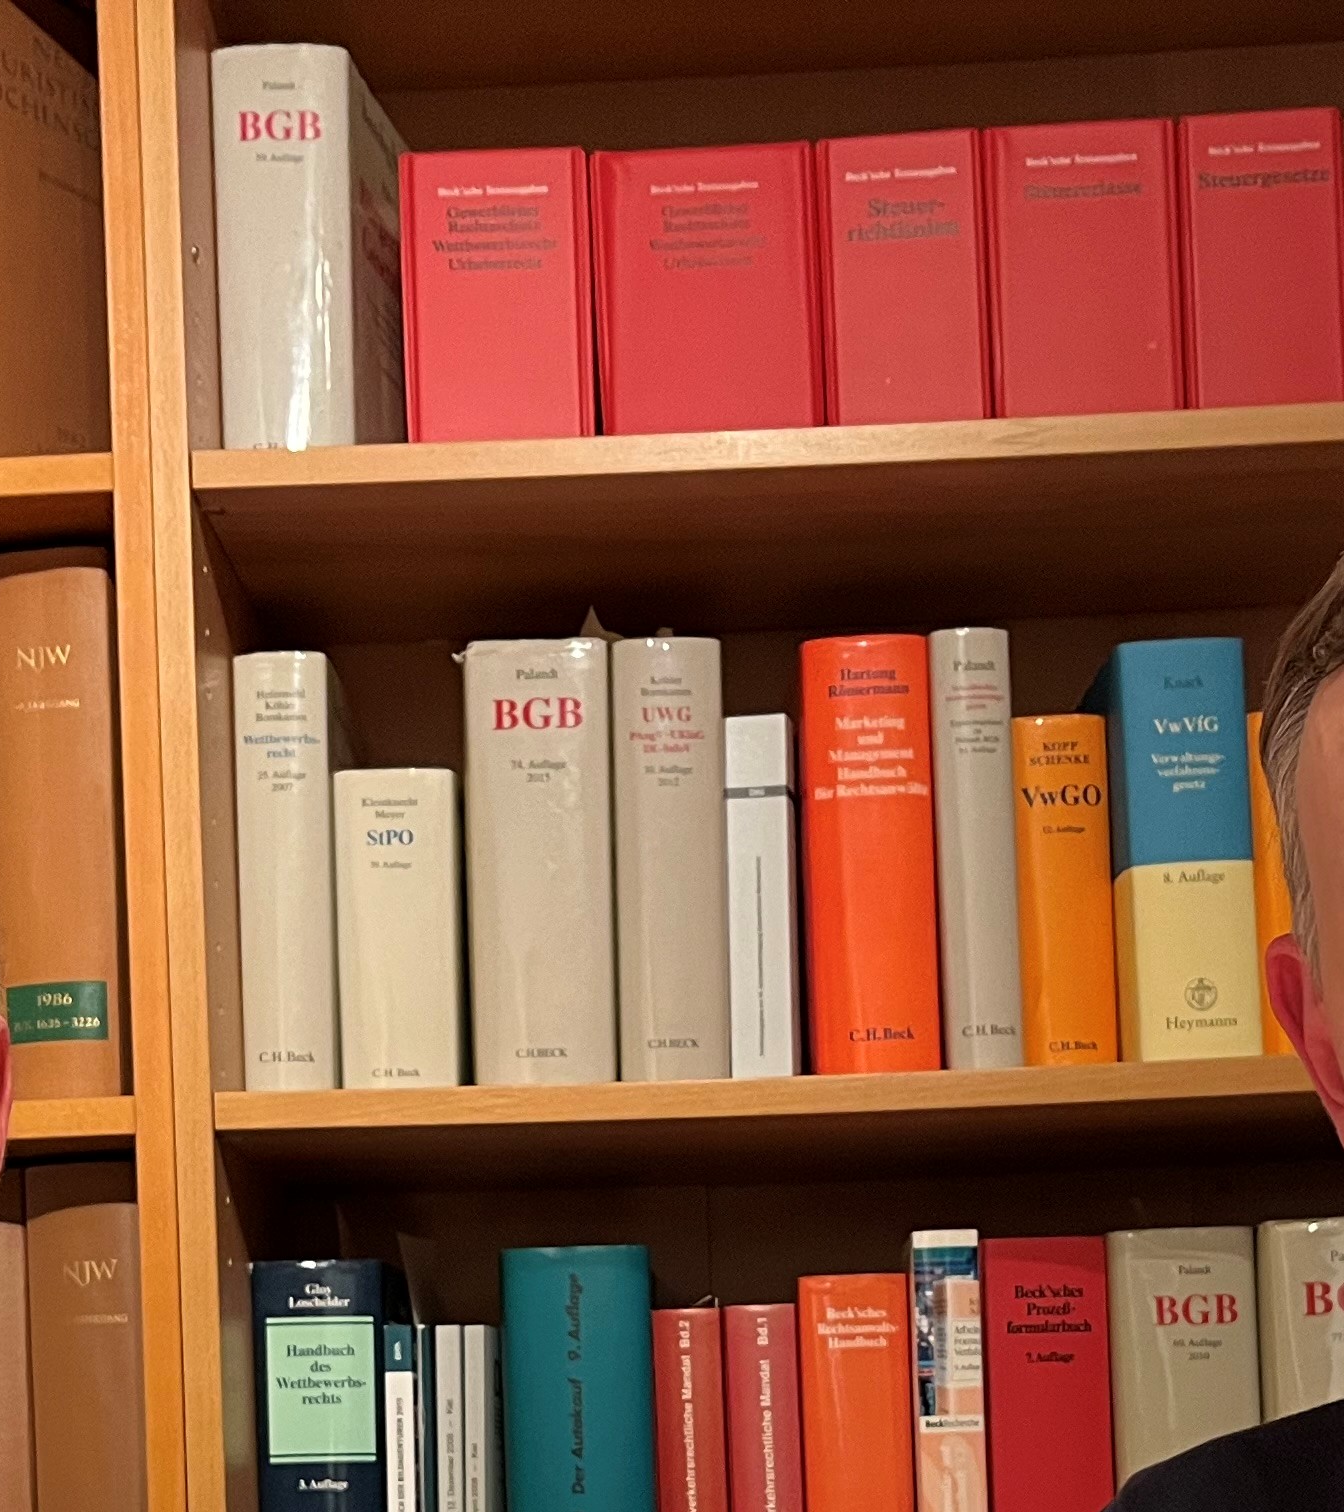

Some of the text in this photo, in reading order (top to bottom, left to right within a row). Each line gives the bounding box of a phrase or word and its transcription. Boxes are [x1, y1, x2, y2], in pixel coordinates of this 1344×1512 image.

[238, 110, 323, 143] BGB
[15, 645, 72, 670] NJW
[515, 669, 559, 680] Palandt
[492, 697, 584, 731] BGB
[641, 706, 693, 723] UWG
[835, 716, 906, 731] Marketing
[1153, 715, 1219, 735] VwVfG
[857, 731, 885, 746] und
[828, 748, 915, 764] Management
[837, 766, 908, 782] Handbuch
[1021, 784, 1103, 808] VwGO
[366, 829, 415, 846] StPO
[1178, 869, 1226, 884] Auflage
[36, 993, 73, 1007] 1986
[1165, 1014, 1239, 1032] Heymanns
[63, 1259, 118, 1287] NJW
[566, 1271, 584, 1342] Auflage
[1153, 1293, 1239, 1328] BGB
[286, 1344, 356, 1357] Handbuch
[828, 1336, 888, 1350] Handbuch
[310, 1361, 332, 1373] des
[276, 1377, 368, 1390] Wettbewerbs-
[680, 1355, 694, 1400] Mandat
[758, 1359, 772, 1406] Mandat
[302, 1394, 343, 1405] rechts
[567, 1376, 586, 1459] Autokauf
[571, 1465, 586, 1495] Der
